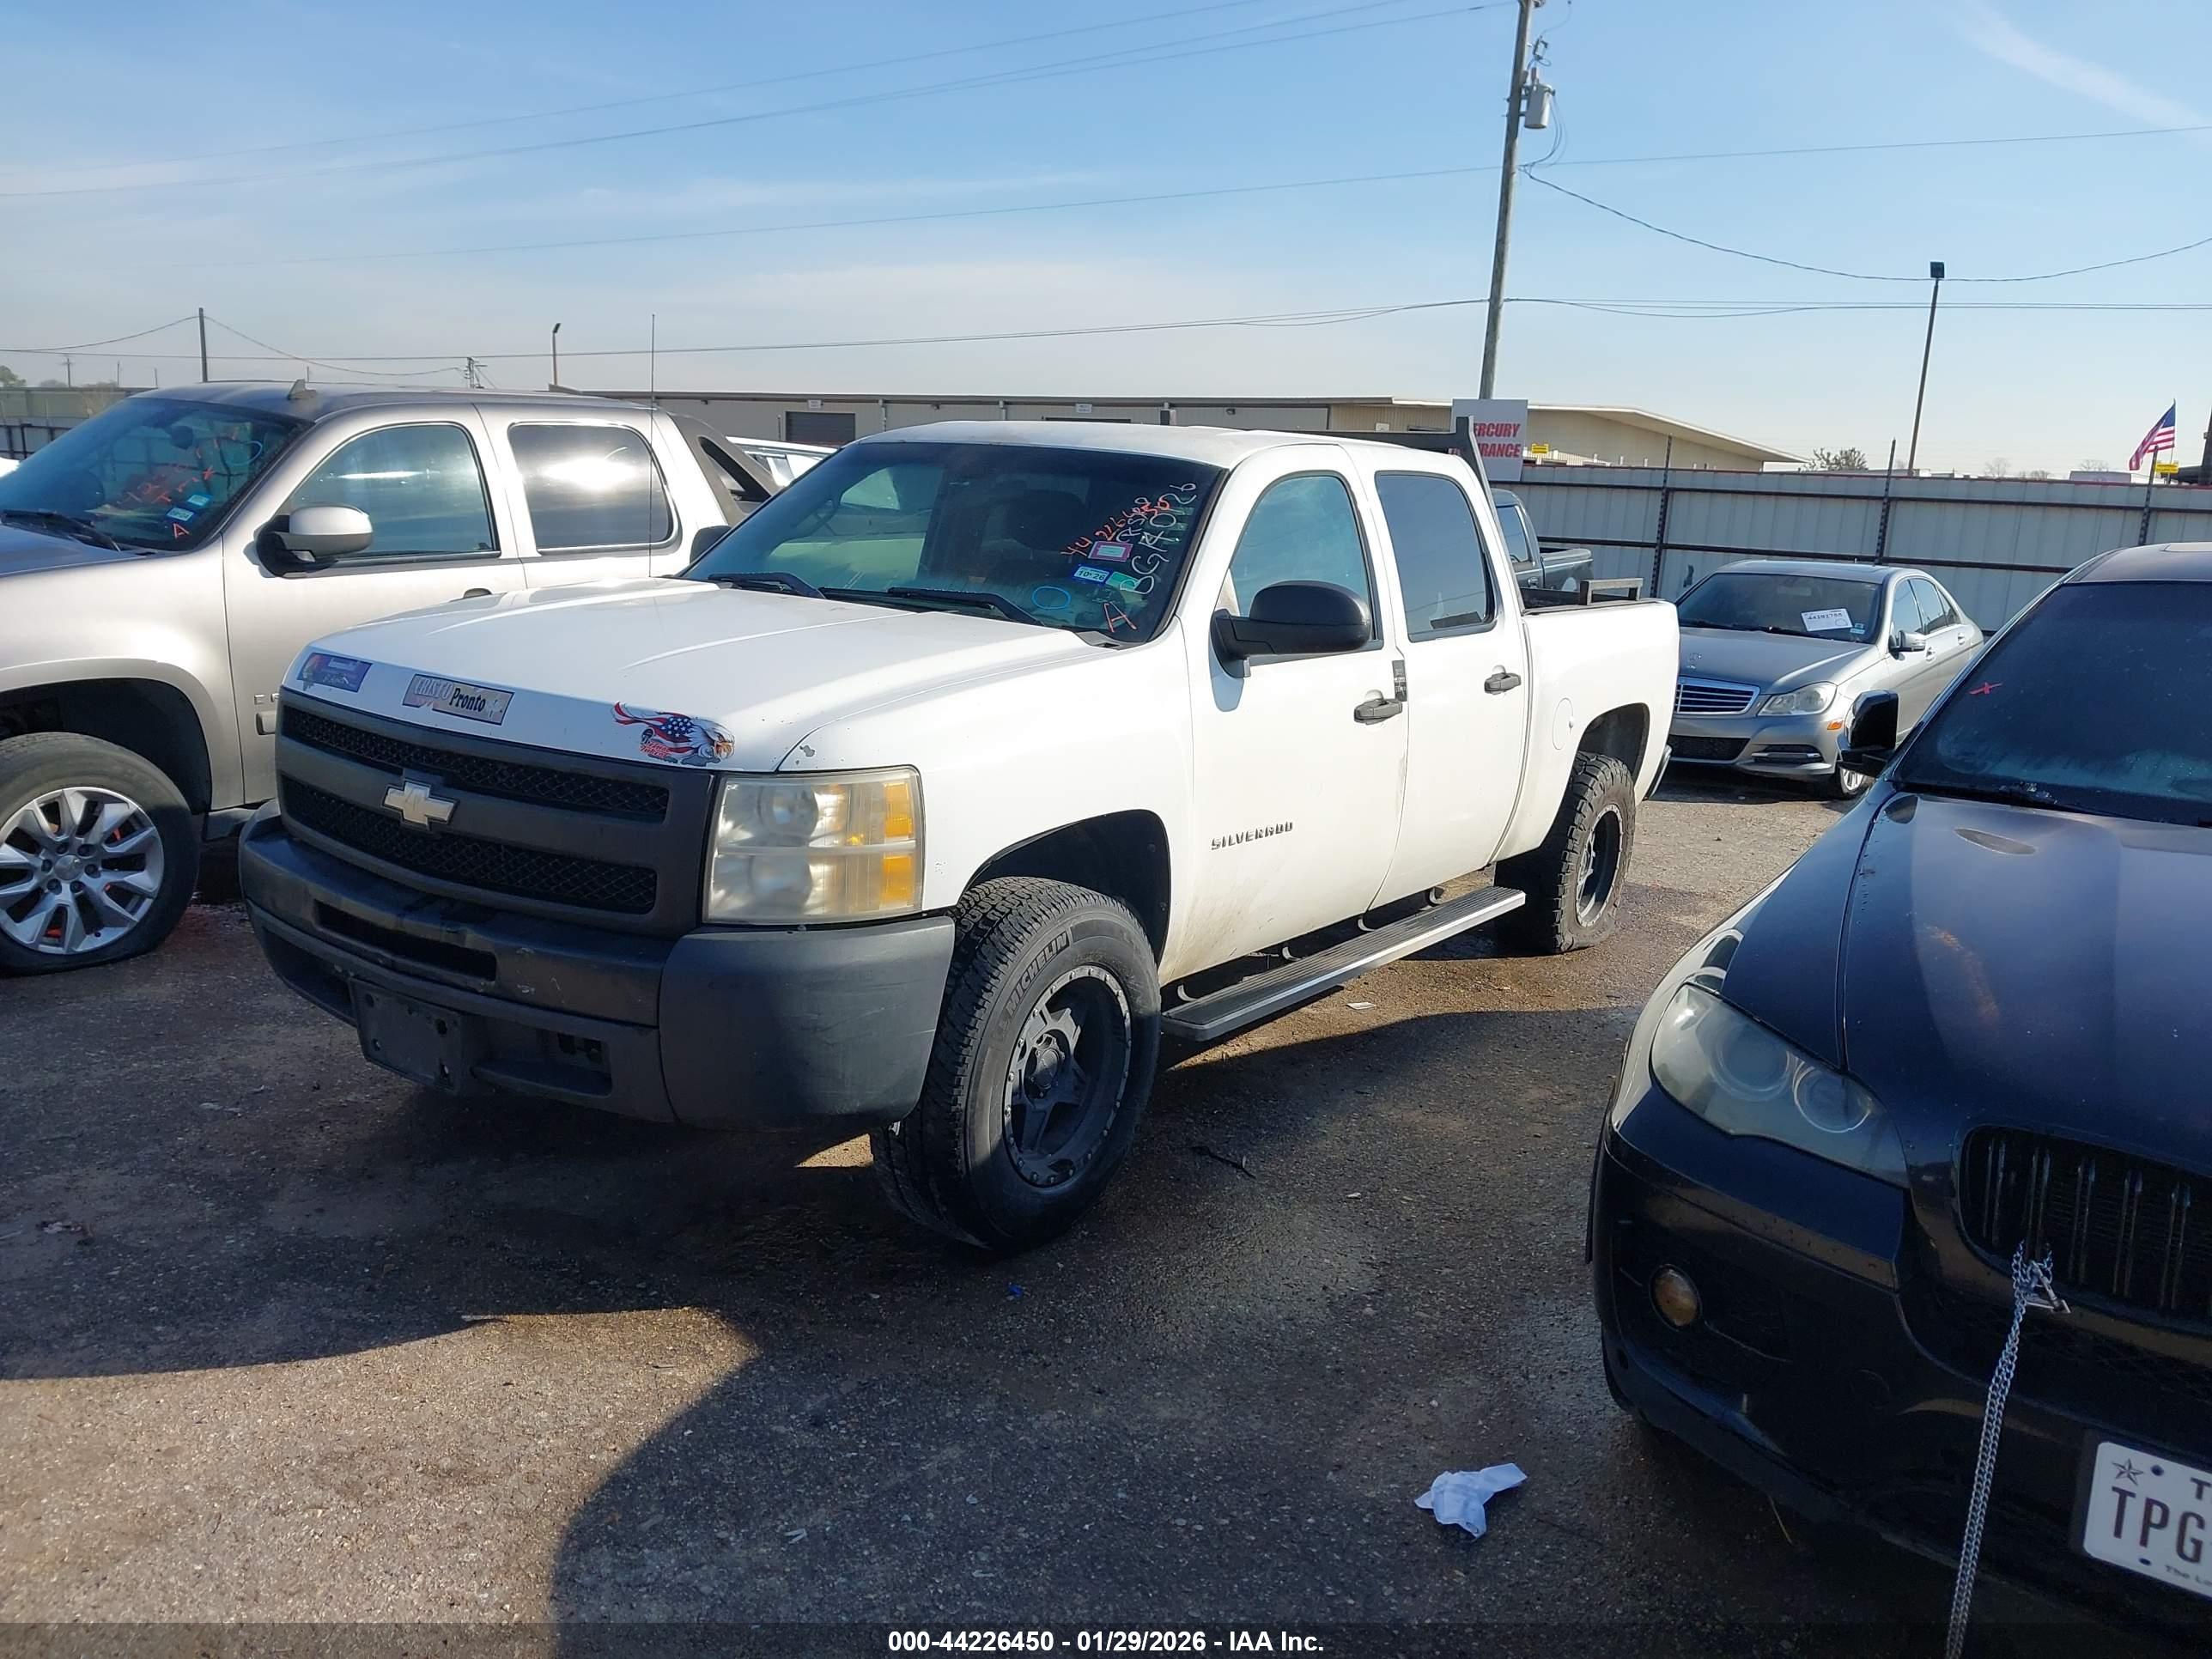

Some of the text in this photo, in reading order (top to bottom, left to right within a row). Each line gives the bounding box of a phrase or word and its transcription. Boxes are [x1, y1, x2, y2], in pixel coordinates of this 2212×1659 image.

[448, 687, 486, 713] Pronto
[1211, 821, 1293, 851] SILVERADO
[1005, 930, 1069, 1018] MICHELIN
[2112, 1486, 2205, 1565] TPG
